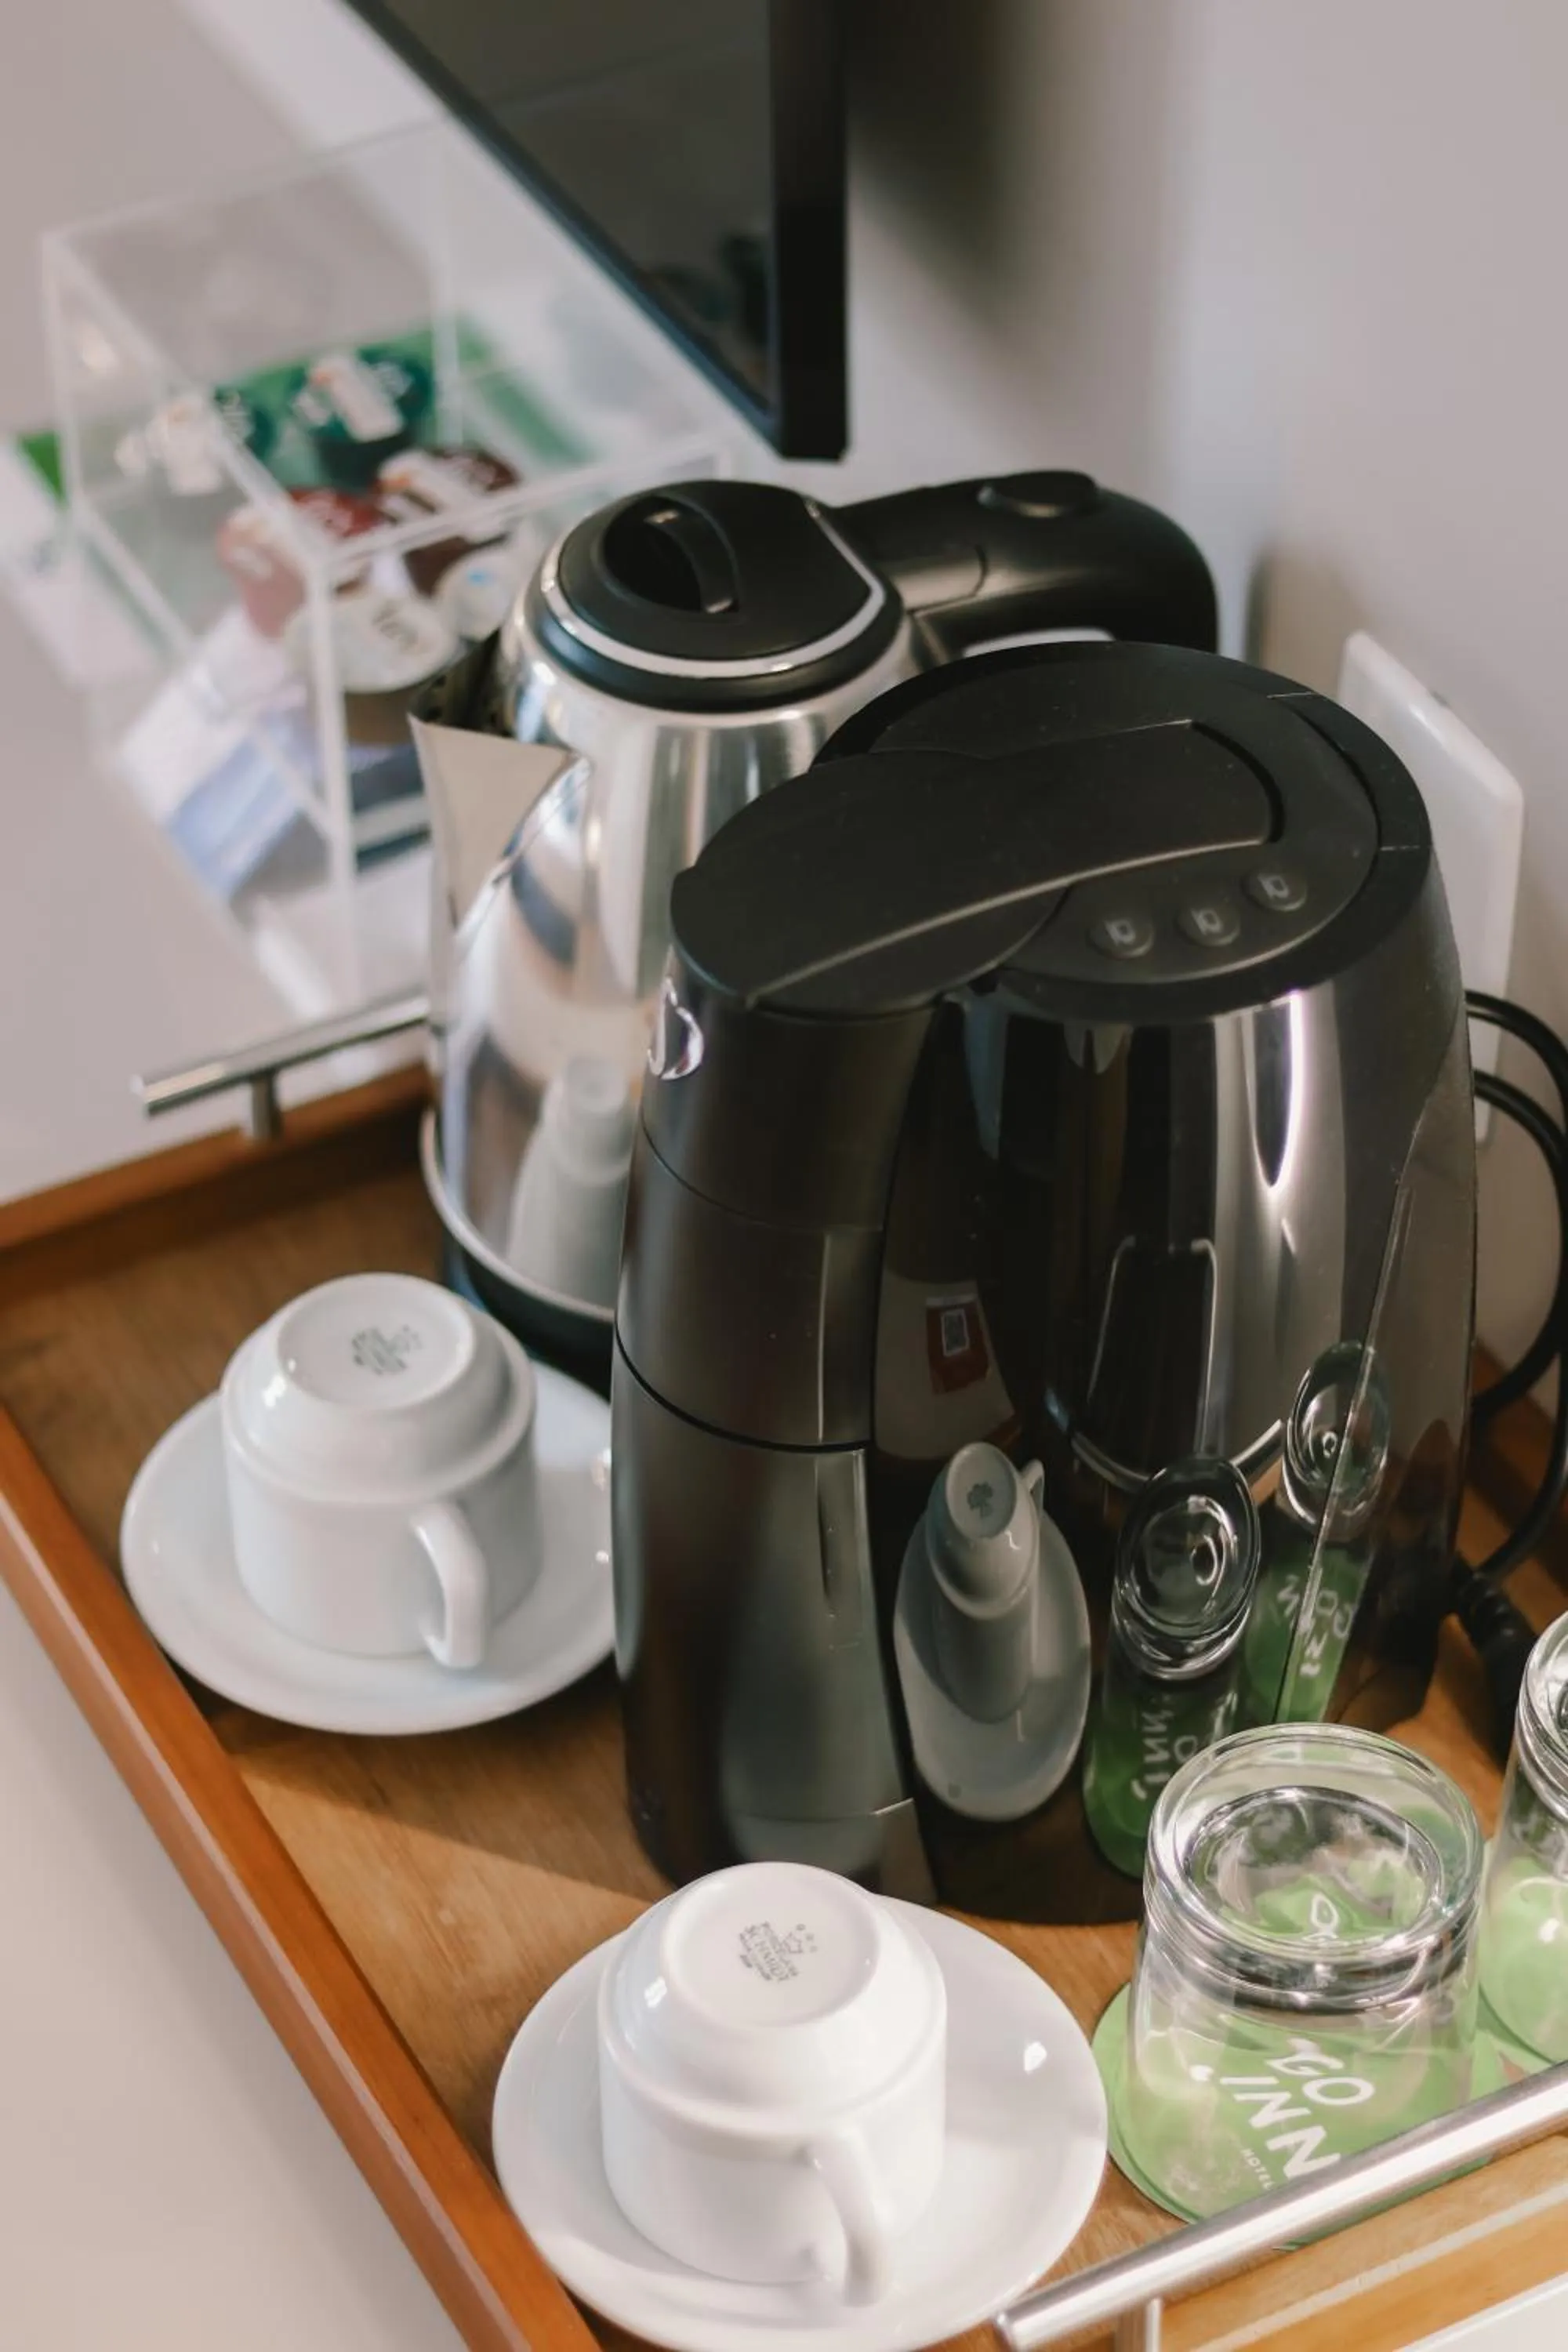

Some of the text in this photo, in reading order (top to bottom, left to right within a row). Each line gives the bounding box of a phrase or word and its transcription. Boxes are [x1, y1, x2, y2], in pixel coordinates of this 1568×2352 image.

[1265, 2045, 1375, 2106] GO
[1220, 2076, 1341, 2179] INN
[1240, 2148, 1276, 2190] HOTEL
